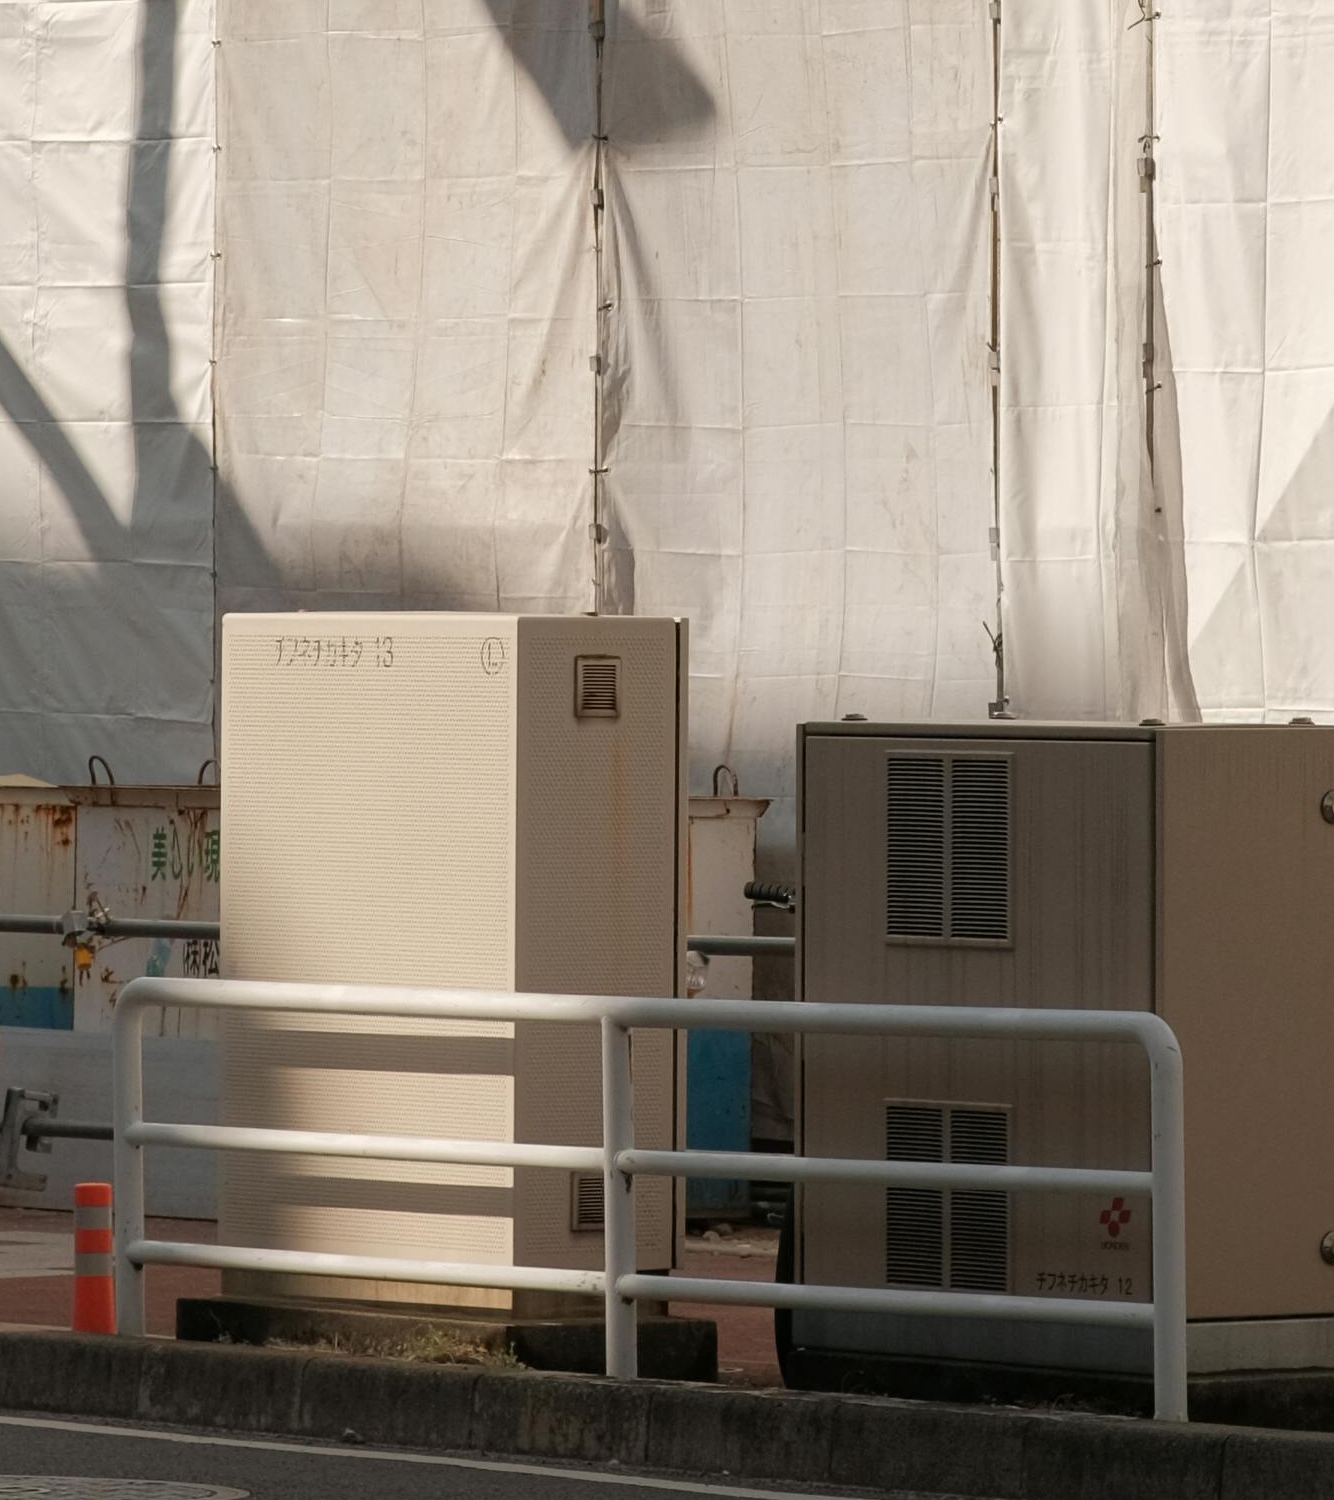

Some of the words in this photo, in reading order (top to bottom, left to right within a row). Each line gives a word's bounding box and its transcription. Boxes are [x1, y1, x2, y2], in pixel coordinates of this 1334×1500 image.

[1036, 1272, 1109, 1296] チフネチカキタ
[1118, 1277, 1133, 1296] 12
